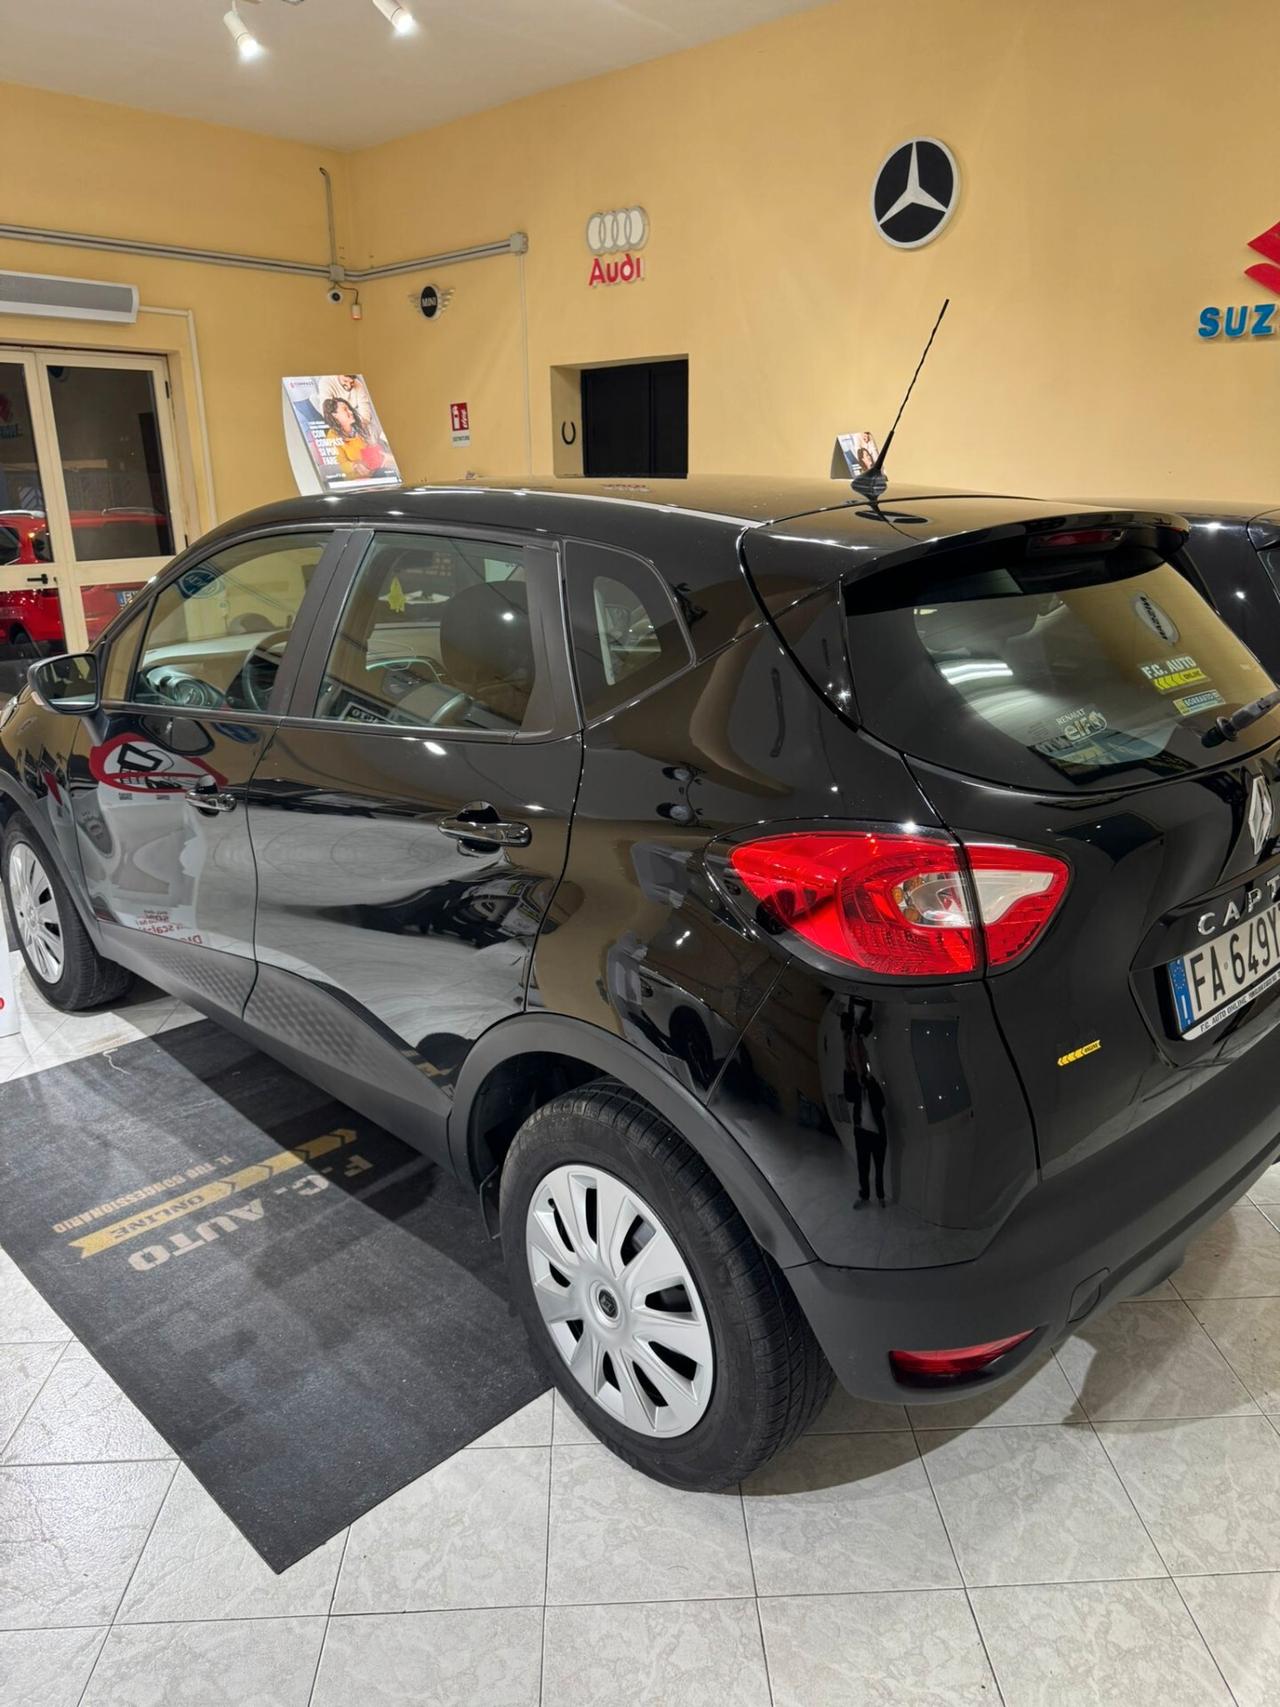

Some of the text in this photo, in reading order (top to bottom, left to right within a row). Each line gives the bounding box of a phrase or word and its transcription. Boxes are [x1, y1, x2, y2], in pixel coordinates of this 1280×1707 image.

[588, 253, 641, 286] Audi
[421, 297, 437, 307] MINI
[1198, 303, 1278, 337] SUZ
[1141, 656, 1197, 679] F.C. AUTO
[1055, 707, 1086, 726] RENAULT
[1212, 1010, 1228, 1025] AUTO
[1227, 996, 1247, 1014] ONLINE
[186, 1162, 216, 1180] TUO
[52, 1173, 185, 1234] CONCESSIONARIO
[109, 1194, 206, 1239] ONLINE
[127, 1198, 265, 1272] AUTO
